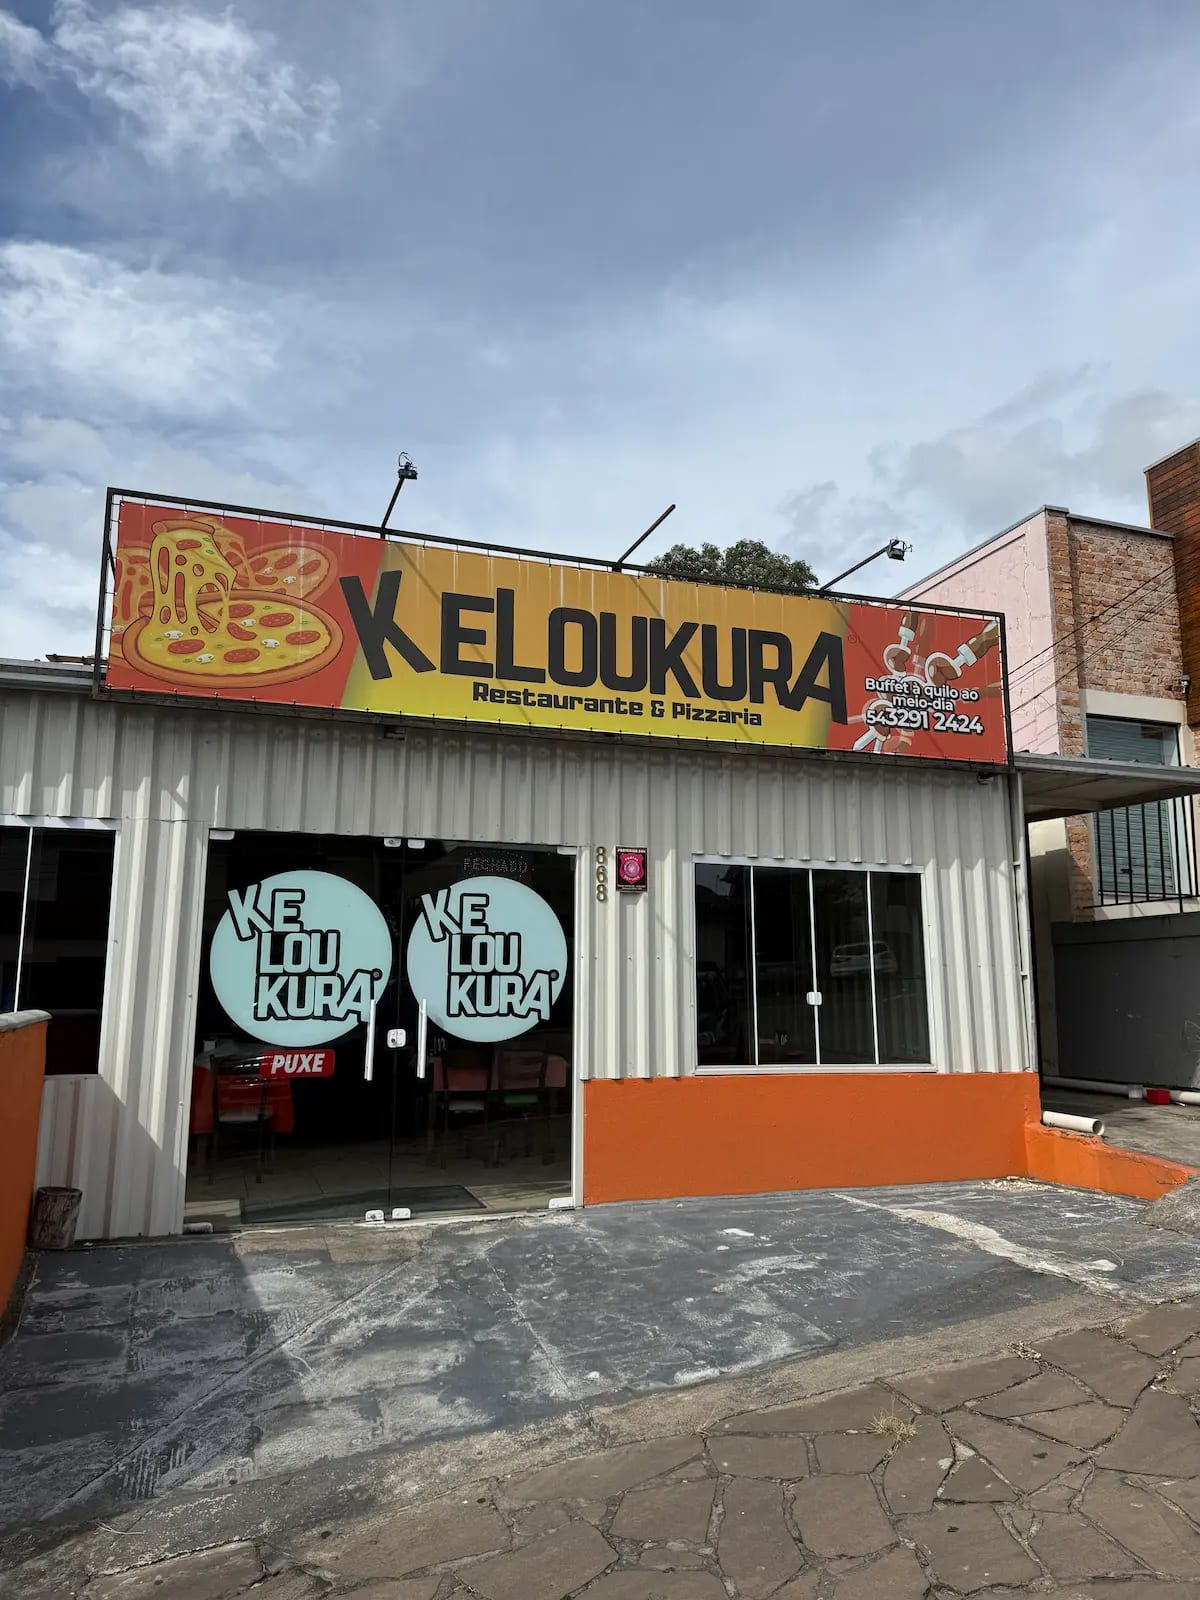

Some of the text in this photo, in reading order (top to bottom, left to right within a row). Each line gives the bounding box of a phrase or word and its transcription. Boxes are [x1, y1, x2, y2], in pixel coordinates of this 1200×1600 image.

[339, 570, 848, 725] KELOUKURA
[472, 682, 762, 726] Restaurante & Pizzaria
[865, 678, 978, 701] Buffet à quilo ao
[893, 696, 953, 710] meio-dia
[933, 713, 983, 733] 2424
[596, 847, 607, 902] 868
[228, 882, 305, 941] KE
[421, 888, 490, 942] KE
[257, 930, 340, 975] LOU
[449, 932, 521, 974] LOU
[254, 970, 374, 1023] KURA
[447, 970, 553, 1021] KURA
[271, 1053, 325, 1075] PUXE
